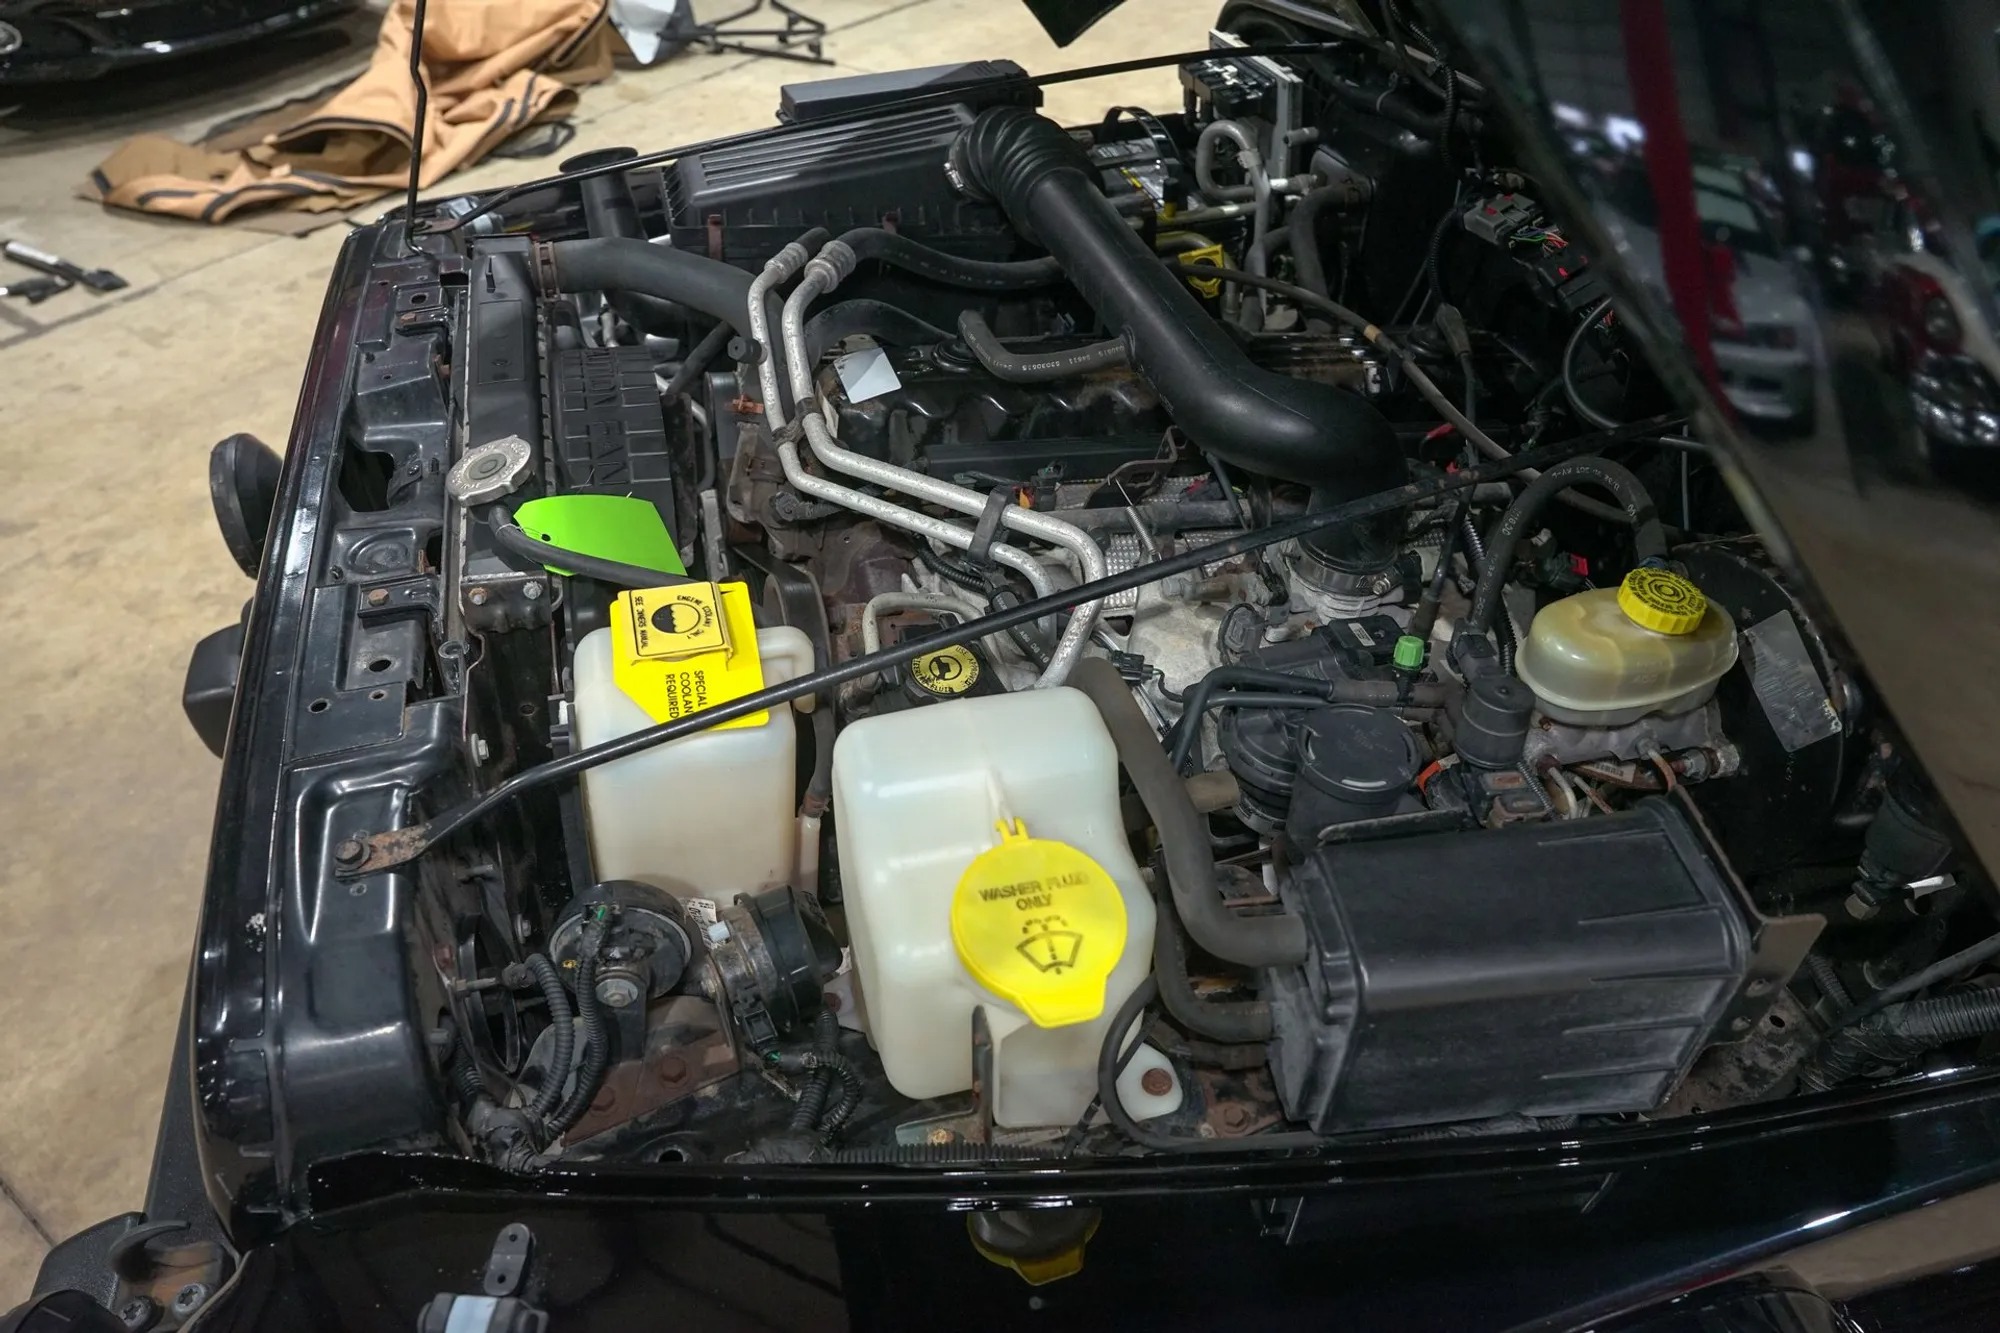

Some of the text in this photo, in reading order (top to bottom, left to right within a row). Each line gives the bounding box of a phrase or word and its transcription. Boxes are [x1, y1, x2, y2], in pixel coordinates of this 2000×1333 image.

[634, 595, 644, 607] SEE
[955, 645, 969, 656] USE
[665, 673, 680, 719] REQUIRED
[680, 671, 694, 714] COOLAN
[694, 670, 708, 707] SPECIAL
[978, 870, 1090, 902] WASHER FLUID
[1015, 893, 1053, 912] ONLY
